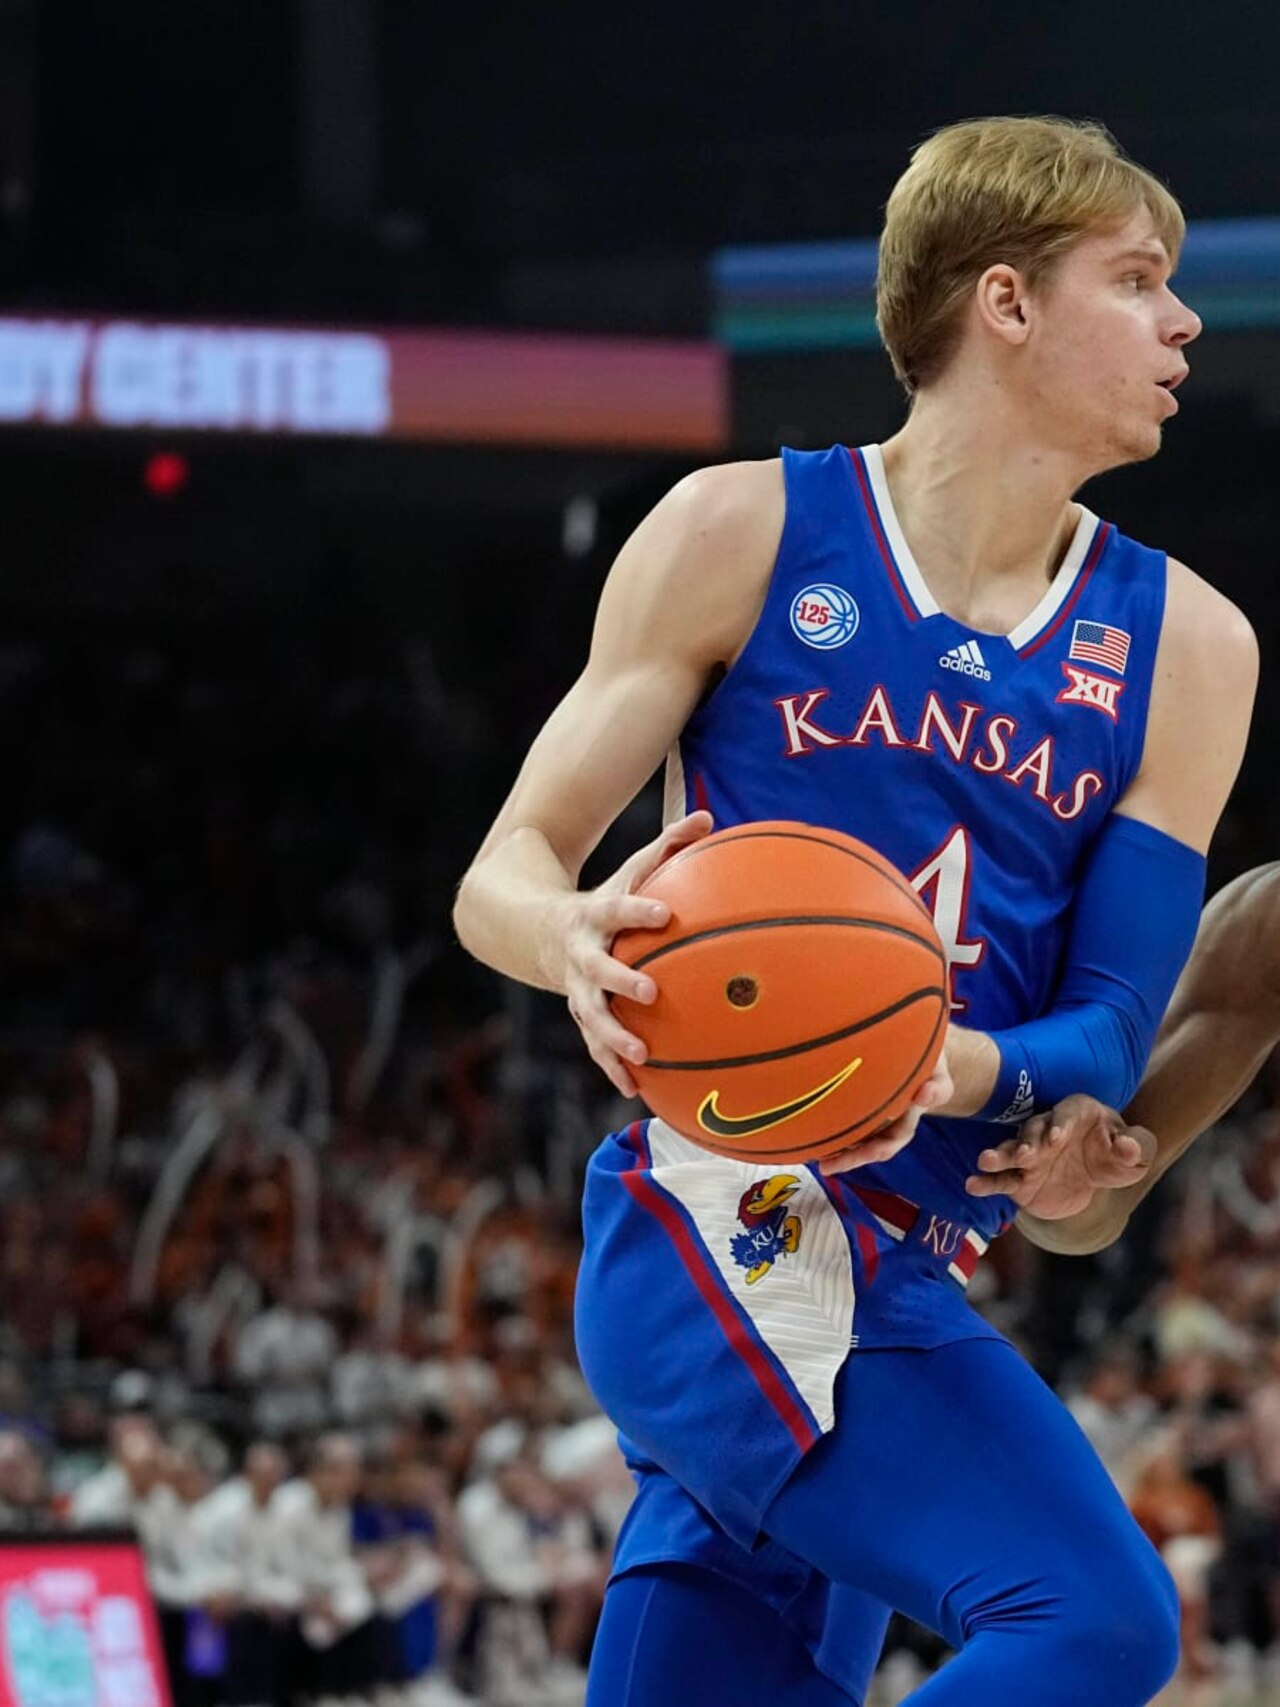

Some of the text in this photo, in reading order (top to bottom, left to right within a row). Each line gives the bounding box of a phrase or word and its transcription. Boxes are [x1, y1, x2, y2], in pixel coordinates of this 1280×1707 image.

[98, 321, 392, 434] CENTER
[798, 600, 830, 625] 125
[938, 655, 991, 682] adidas
[774, 684, 1104, 820] KANSAS
[909, 823, 986, 1021] 4
[751, 1226, 775, 1251] KU
[922, 1214, 961, 1256] KU
